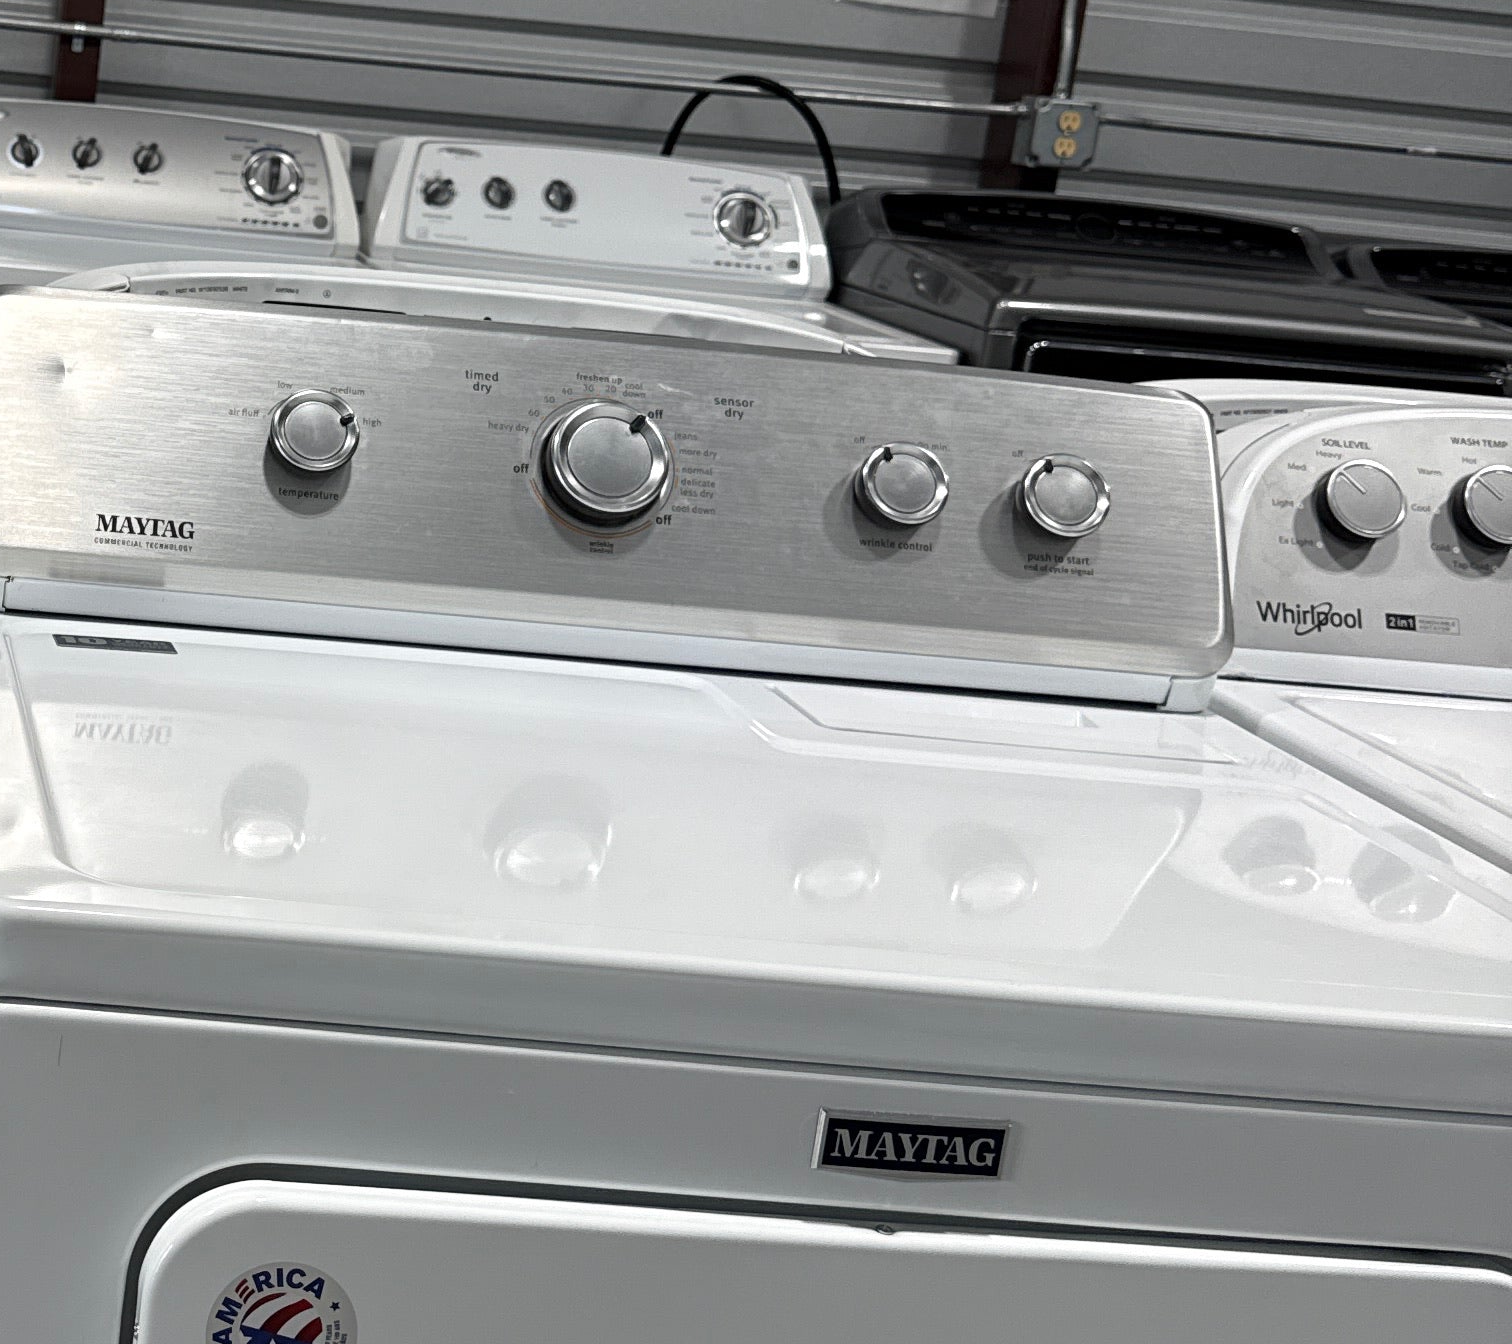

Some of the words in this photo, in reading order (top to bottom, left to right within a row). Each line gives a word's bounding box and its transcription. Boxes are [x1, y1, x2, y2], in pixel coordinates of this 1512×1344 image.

[465, 368, 499, 382] timed
[576, 372, 608, 383] freshen
[610, 376, 623, 386] up
[277, 380, 293, 390] low
[329, 384, 366, 397] medium
[472, 381, 492, 395] dry
[625, 381, 643, 390] cool
[561, 387, 573, 396] 40
[622, 389, 646, 398] down
[714, 395, 755, 408] sensor
[528, 408, 540, 417] 60
[648, 408, 663, 419] off
[724, 406, 745, 421] dry
[362, 416, 382, 428] high
[488, 420, 513, 433] heavy
[515, 423, 530, 434] dry
[673, 431, 698, 441] jeans
[853, 435, 866, 444] off
[1321, 438, 1342, 448] SOIL
[1343, 440, 1370, 450] LEVEL
[1450, 436, 1480, 447] WASH
[1481, 439, 1508, 449] TEMP
[679, 447, 701, 457] more
[704, 448, 718, 460] dry
[1012, 449, 1024, 458] off
[1316, 450, 1342, 460] Heavy
[1462, 456, 1477, 464] Hot
[513, 462, 530, 474] off
[681, 466, 713, 476] normal
[1288, 462, 1307, 471] Med
[1417, 468, 1442, 476] Warm
[680, 478, 716, 489] delicate
[278, 486, 340, 501] temperature
[680, 487, 698, 498] less
[700, 488, 714, 499] dry
[671, 504, 690, 513] cool
[692, 505, 716, 515] down
[1272, 498, 1295, 509] Light
[1411, 503, 1431, 513] Cool
[656, 514, 672, 526] off
[95, 513, 195, 540] MAYTAG
[94, 536, 143, 549] COMMERCIAL
[859, 536, 896, 550] wrinkle
[898, 539, 933, 552] control
[1291, 537, 1314, 548] Light
[1027, 551, 1051, 564] push
[1054, 553, 1064, 563] to
[1066, 555, 1090, 566] start
[1256, 600, 1363, 636] Whirlpool
[830, 1128, 996, 1167] MAYTAG
